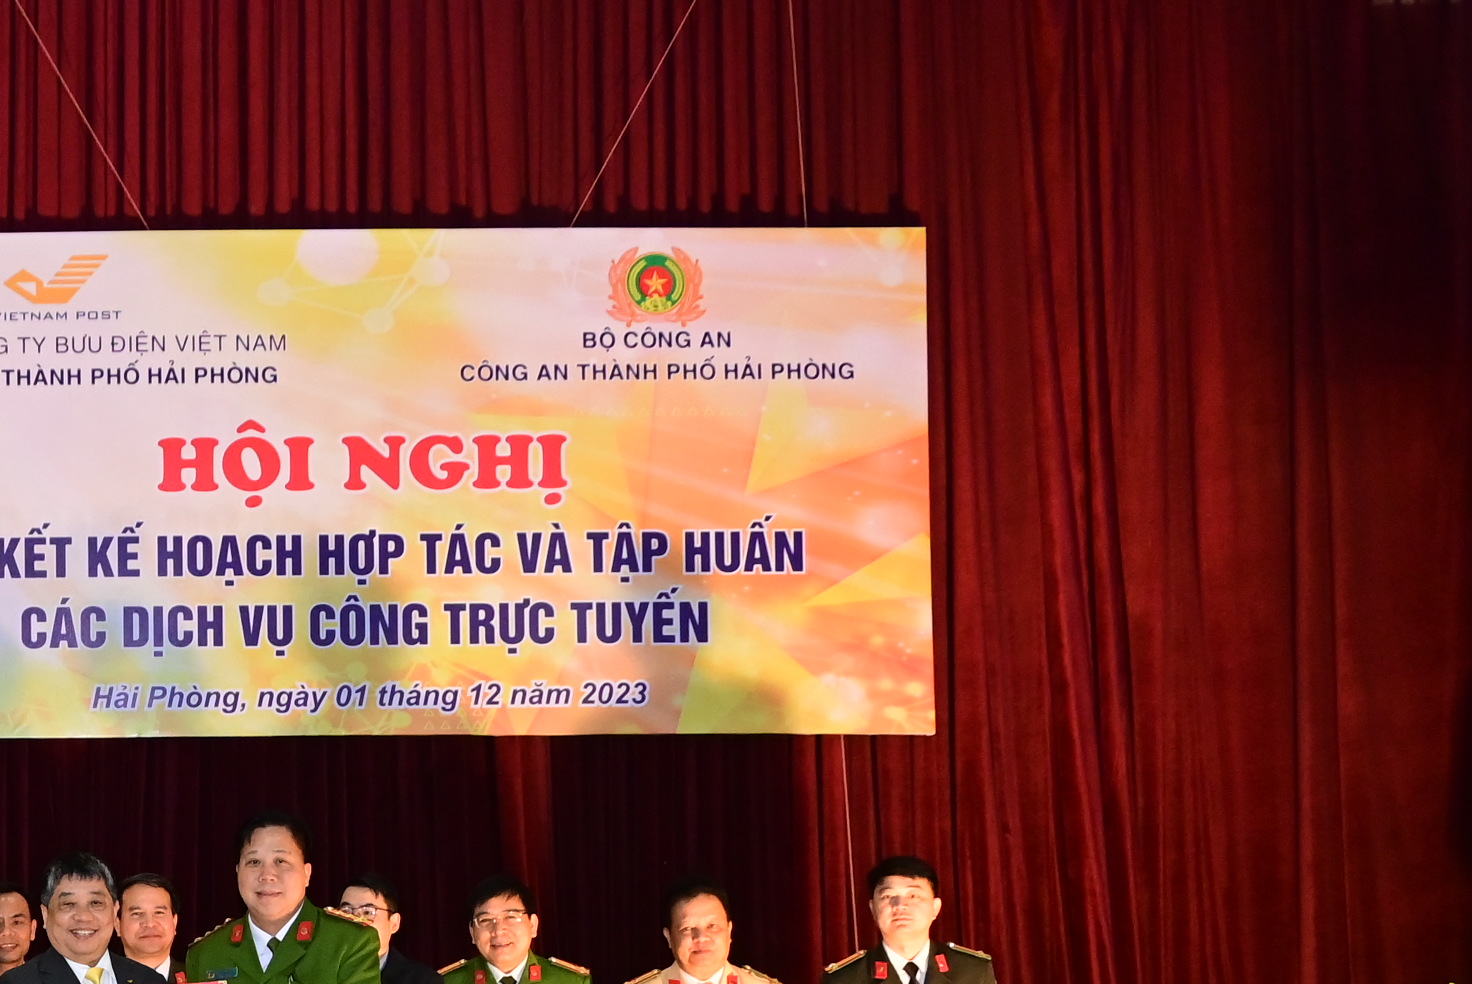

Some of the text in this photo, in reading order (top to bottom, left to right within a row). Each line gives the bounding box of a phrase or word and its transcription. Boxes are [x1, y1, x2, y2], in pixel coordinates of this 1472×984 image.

[76, 310, 122, 321] POST
[17, 337, 47, 354] TY
[55, 334, 103, 354] BƯU
[110, 330, 166, 357] ĐIỆN
[175, 330, 227, 356] VIỆT
[235, 333, 287, 353] NAM
[582, 327, 732, 353] BỘ CÔNG AN
[1, 362, 82, 387] THÀNH
[90, 360, 141, 385] PHỐ
[147, 361, 186, 385] HẢI
[194, 361, 278, 385] PHÒNG
[460, 355, 855, 383] CÔNG AN THÀNH PHỐ HẢI PHÒNG
[157, 418, 569, 508] HỘI NGHỊ
[88, 521, 144, 578] KẾ
[157, 534, 302, 587] HOẠCH
[319, 529, 404, 585] HỢP
[420, 523, 501, 575] TÁC
[517, 522, 572, 574] VÀ
[587, 521, 668, 582] TẬP
[684, 513, 804, 573] HUẤN
[21, 586, 709, 657] CÁC DỊCH VỤ CÔNG TRỰC TUYẾN
[92, 681, 648, 713] Hải Phòng, ngày 01 tháng 12 năm 2023
